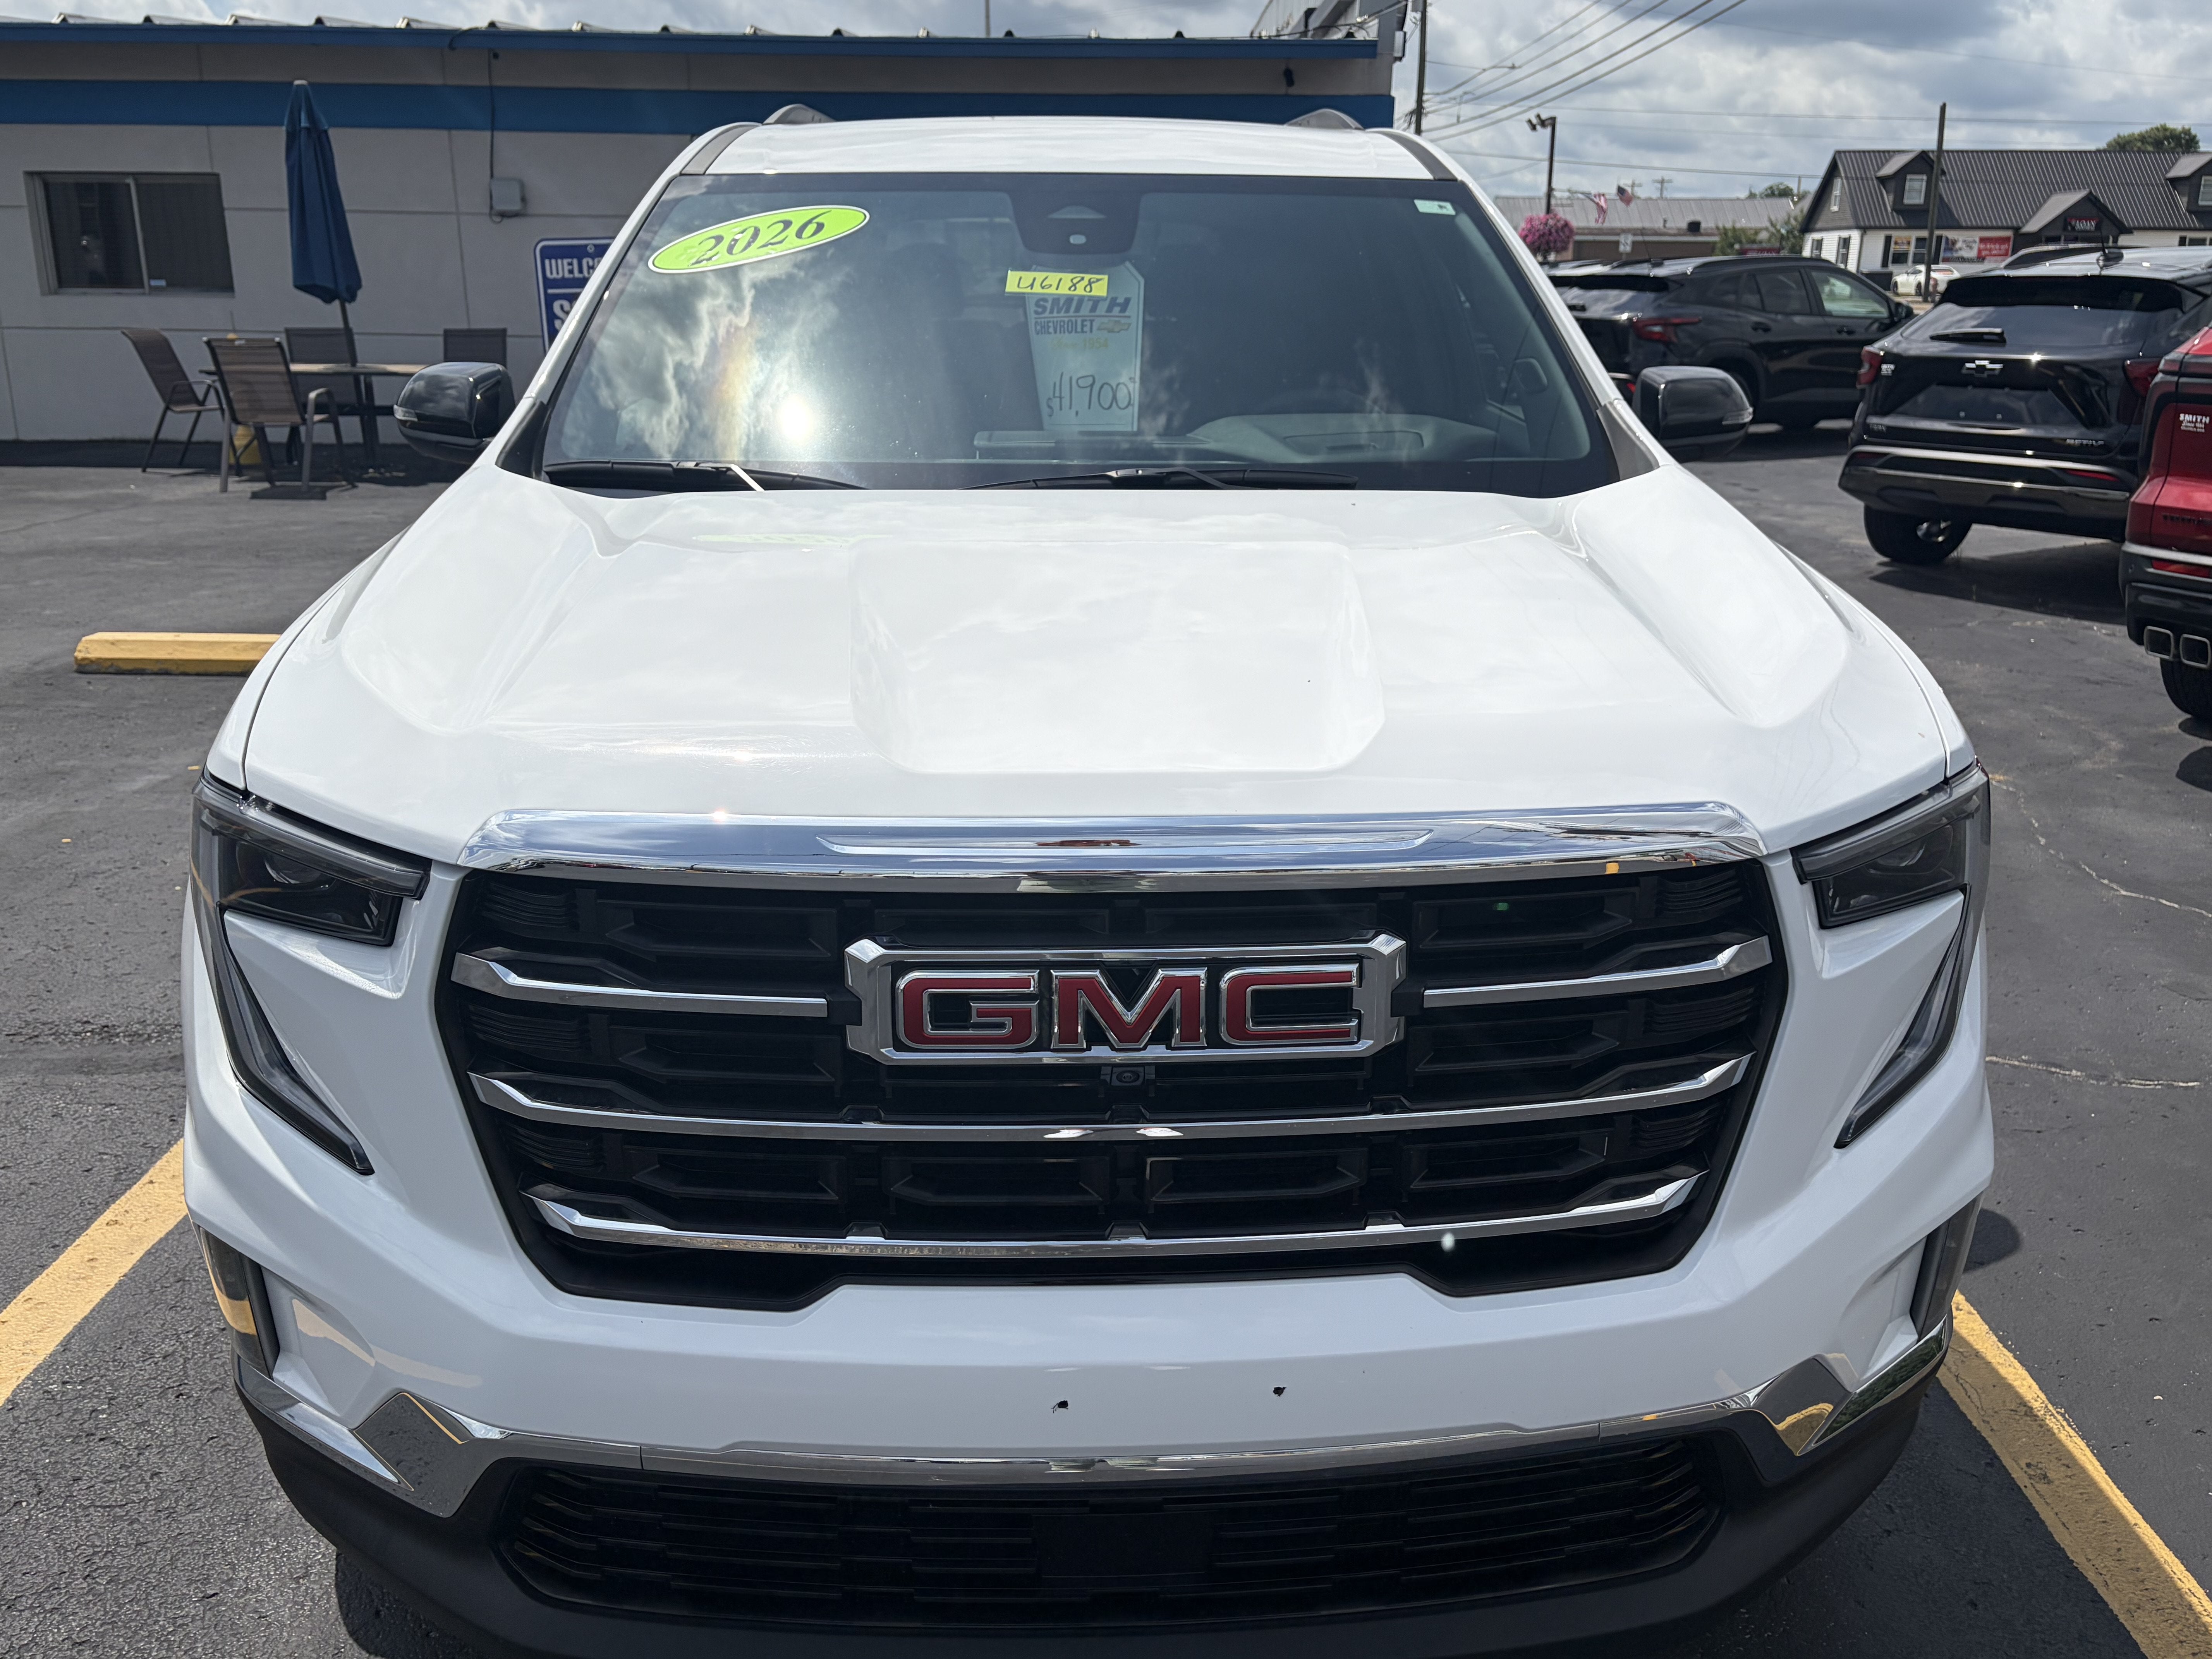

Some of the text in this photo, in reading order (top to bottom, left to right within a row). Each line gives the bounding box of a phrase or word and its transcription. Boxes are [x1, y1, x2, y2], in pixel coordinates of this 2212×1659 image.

[688, 210, 832, 267] 2026
[1017, 275, 1105, 293] U6188
[1034, 296, 1132, 316] SMITH
[1034, 319, 1096, 335] CHEVROLET
[1083, 337, 1109, 349] 1954
[2179, 413, 2210, 424] SMITH
[896, 964, 1362, 1049] GMC
